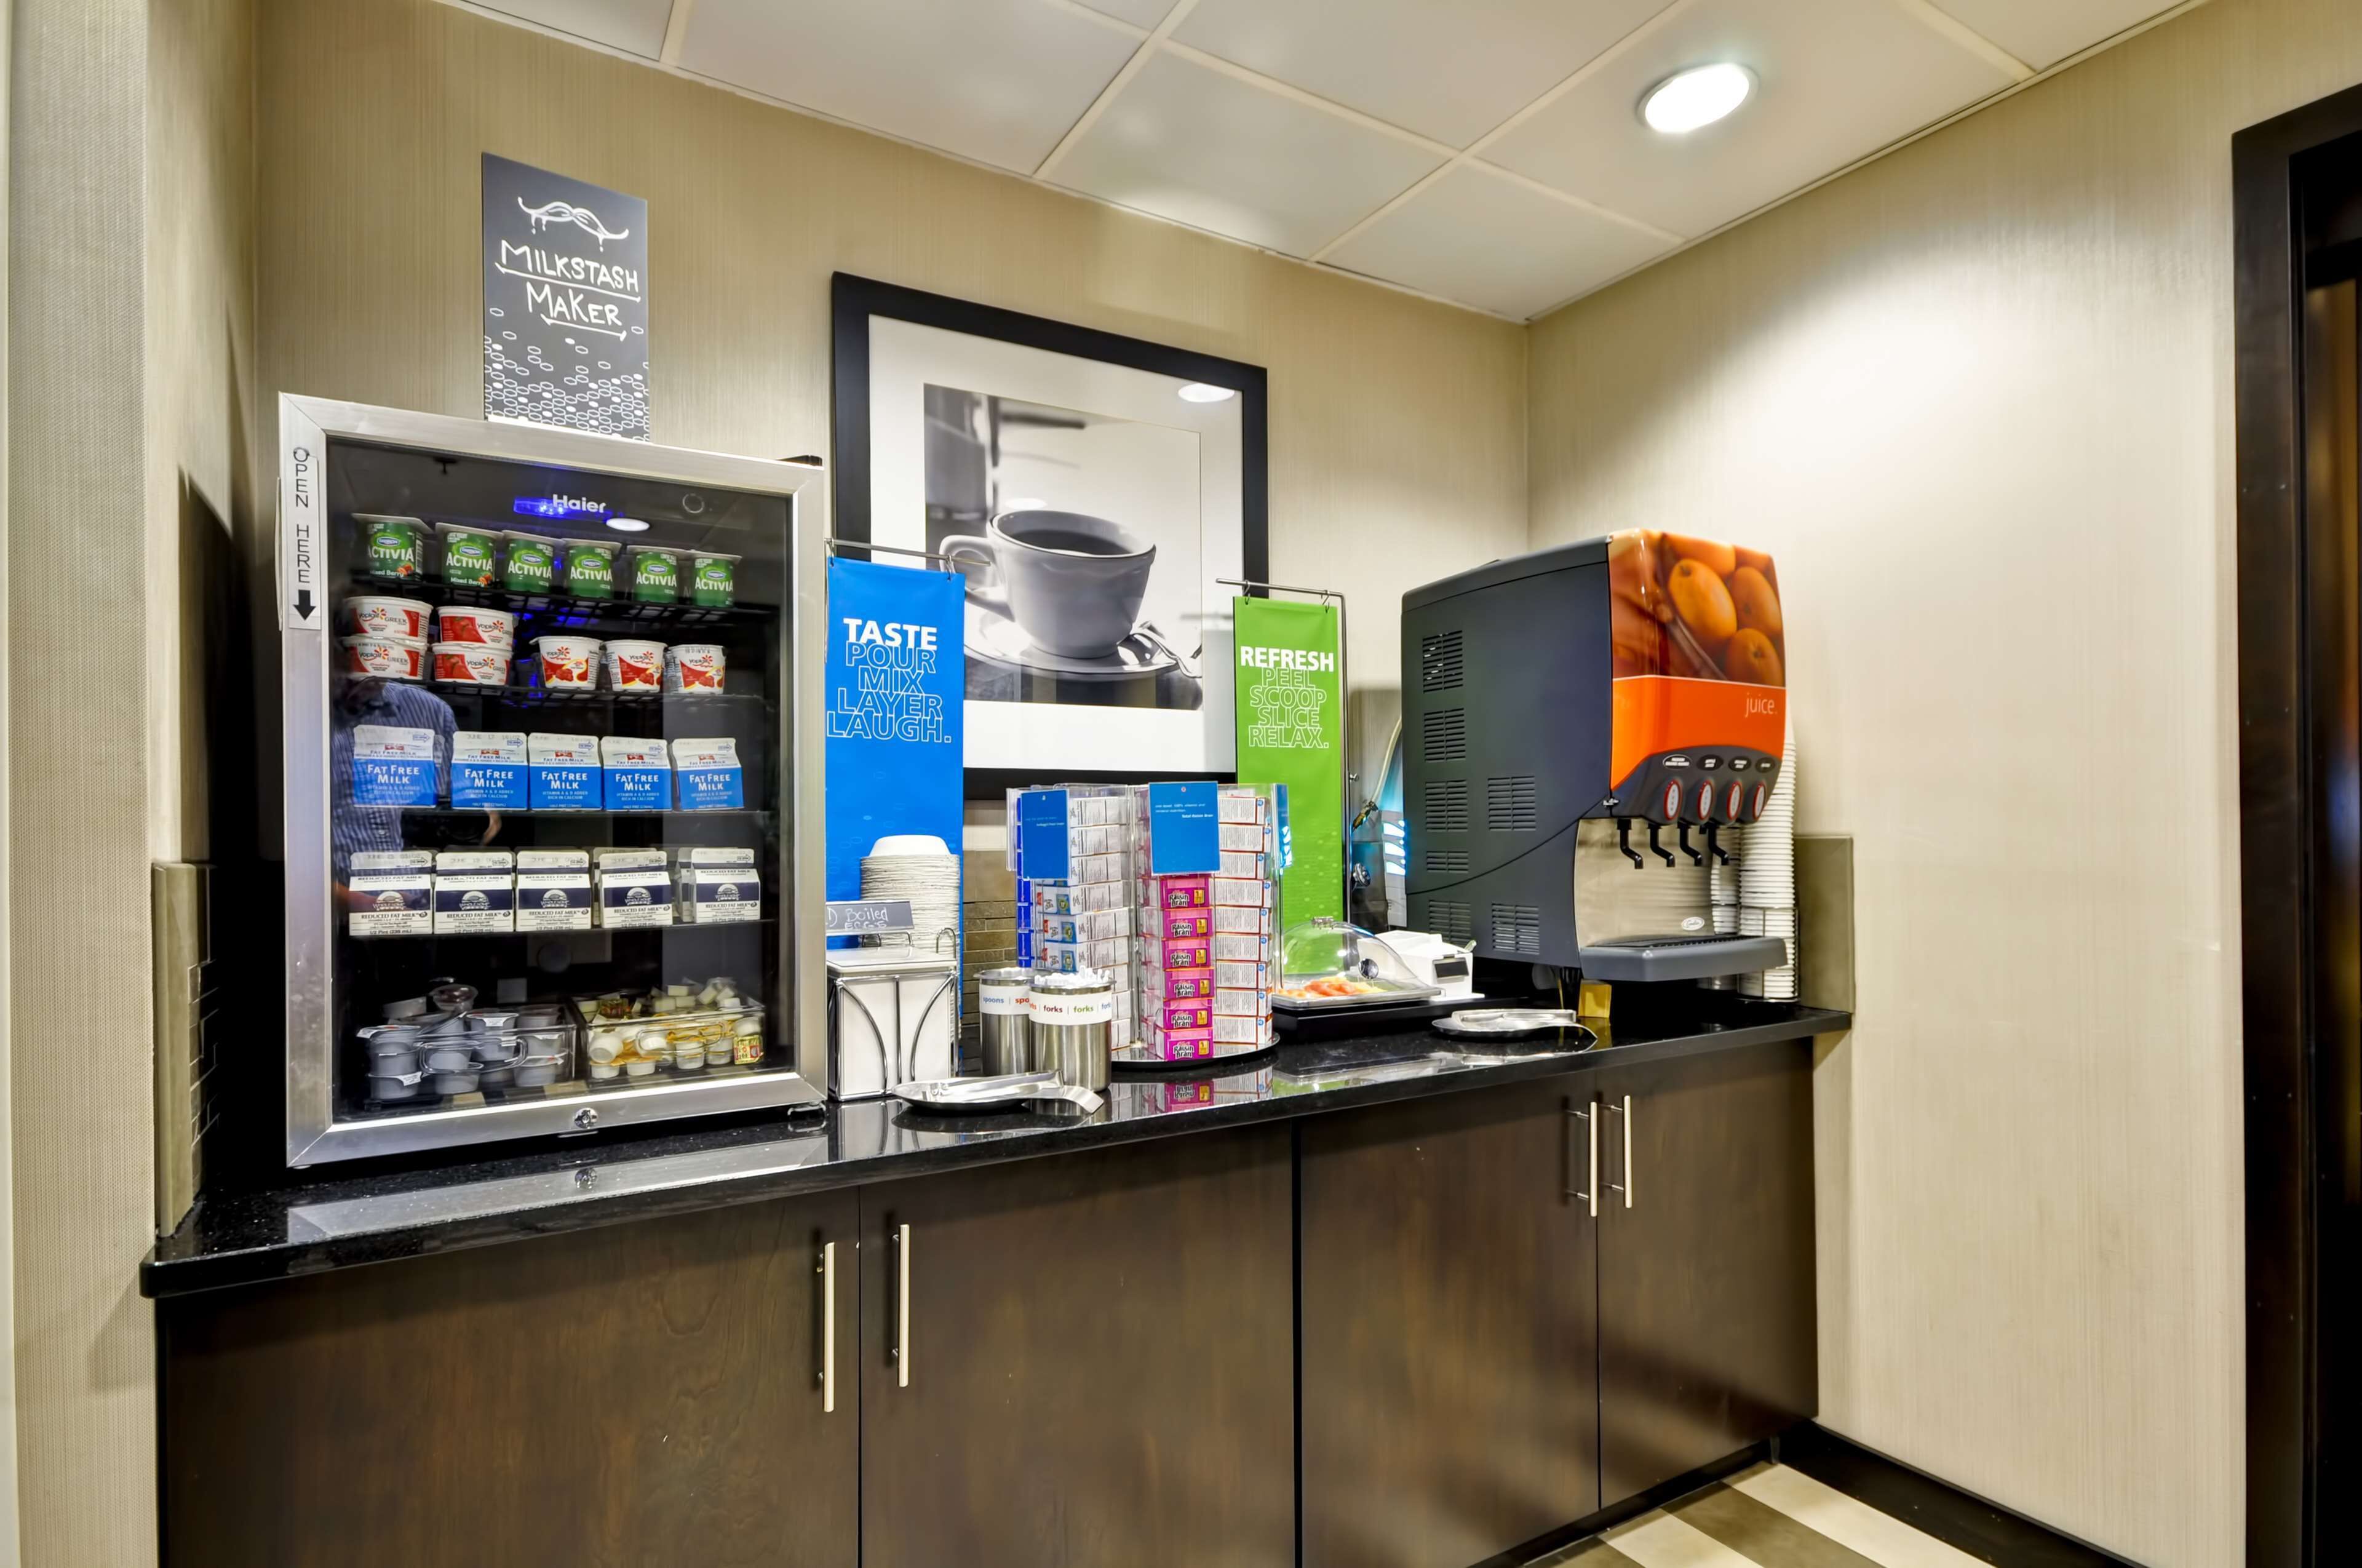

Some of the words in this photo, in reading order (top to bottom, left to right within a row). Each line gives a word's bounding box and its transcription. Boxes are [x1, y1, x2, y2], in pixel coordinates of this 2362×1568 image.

[501, 239, 639, 293] MILKSTASH
[527, 282, 622, 326] MAKER
[293, 447, 310, 507] OPEN
[552, 493, 606, 514] Haier
[296, 523, 311, 584] HERE
[446, 552, 493, 571] ACTIVIA
[508, 560, 552, 579] ACTIVIA
[570, 566, 613, 582] ACTIVIA
[636, 571, 677, 587] ACTIVIA
[468, 578, 485, 587] Berry
[695, 576, 733, 592] ACTIVIA
[843, 618, 937, 651] TASTE
[846, 641, 936, 674] POUR
[1240, 645, 1335, 672] REFRESH
[858, 665, 925, 694] MIX
[1262, 667, 1316, 688] PEEL
[838, 687, 943, 720] LAYER
[1250, 685, 1327, 710] SCOOP
[826, 710, 952, 743] LAUGH.
[1257, 706, 1320, 730] SLICE
[1249, 725, 1329, 749] RELAX.
[378, 774, 410, 784] MILK
[391, 765, 420, 775] FREE
[487, 769, 514, 779] FREE
[562, 771, 588, 781] FREE
[634, 773, 659, 782] FREE
[707, 773, 731, 782] FREE
[474, 778, 504, 788] MILK
[551, 780, 579, 789] MILK
[624, 782, 651, 791] MILK
[698, 782, 724, 791] MILK
[845, 906, 889, 923] Boiled
[1043, 1005, 1063, 1013] forks
